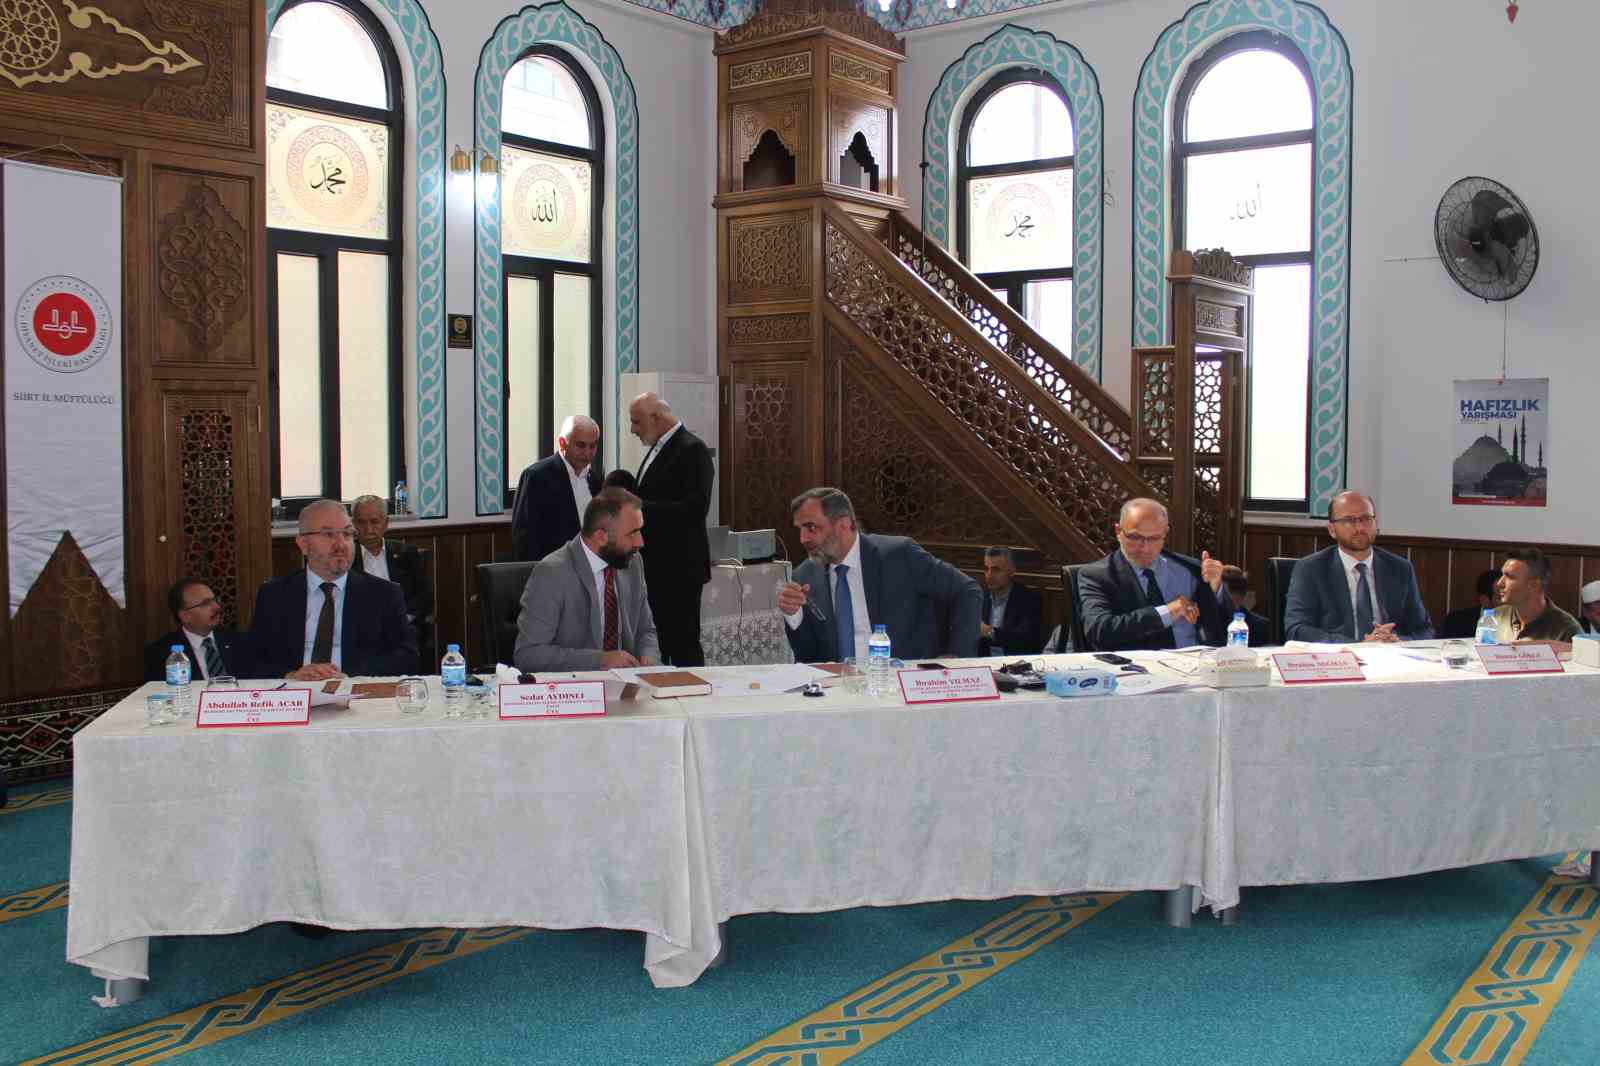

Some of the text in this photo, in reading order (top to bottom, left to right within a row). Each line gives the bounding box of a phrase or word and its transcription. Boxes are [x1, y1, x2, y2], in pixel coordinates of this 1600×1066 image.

[1460, 399, 1540, 411] HAFIZLIK
[1461, 411, 1518, 421] YARIŞMASI
[207, 701, 248, 710] Abdullah
